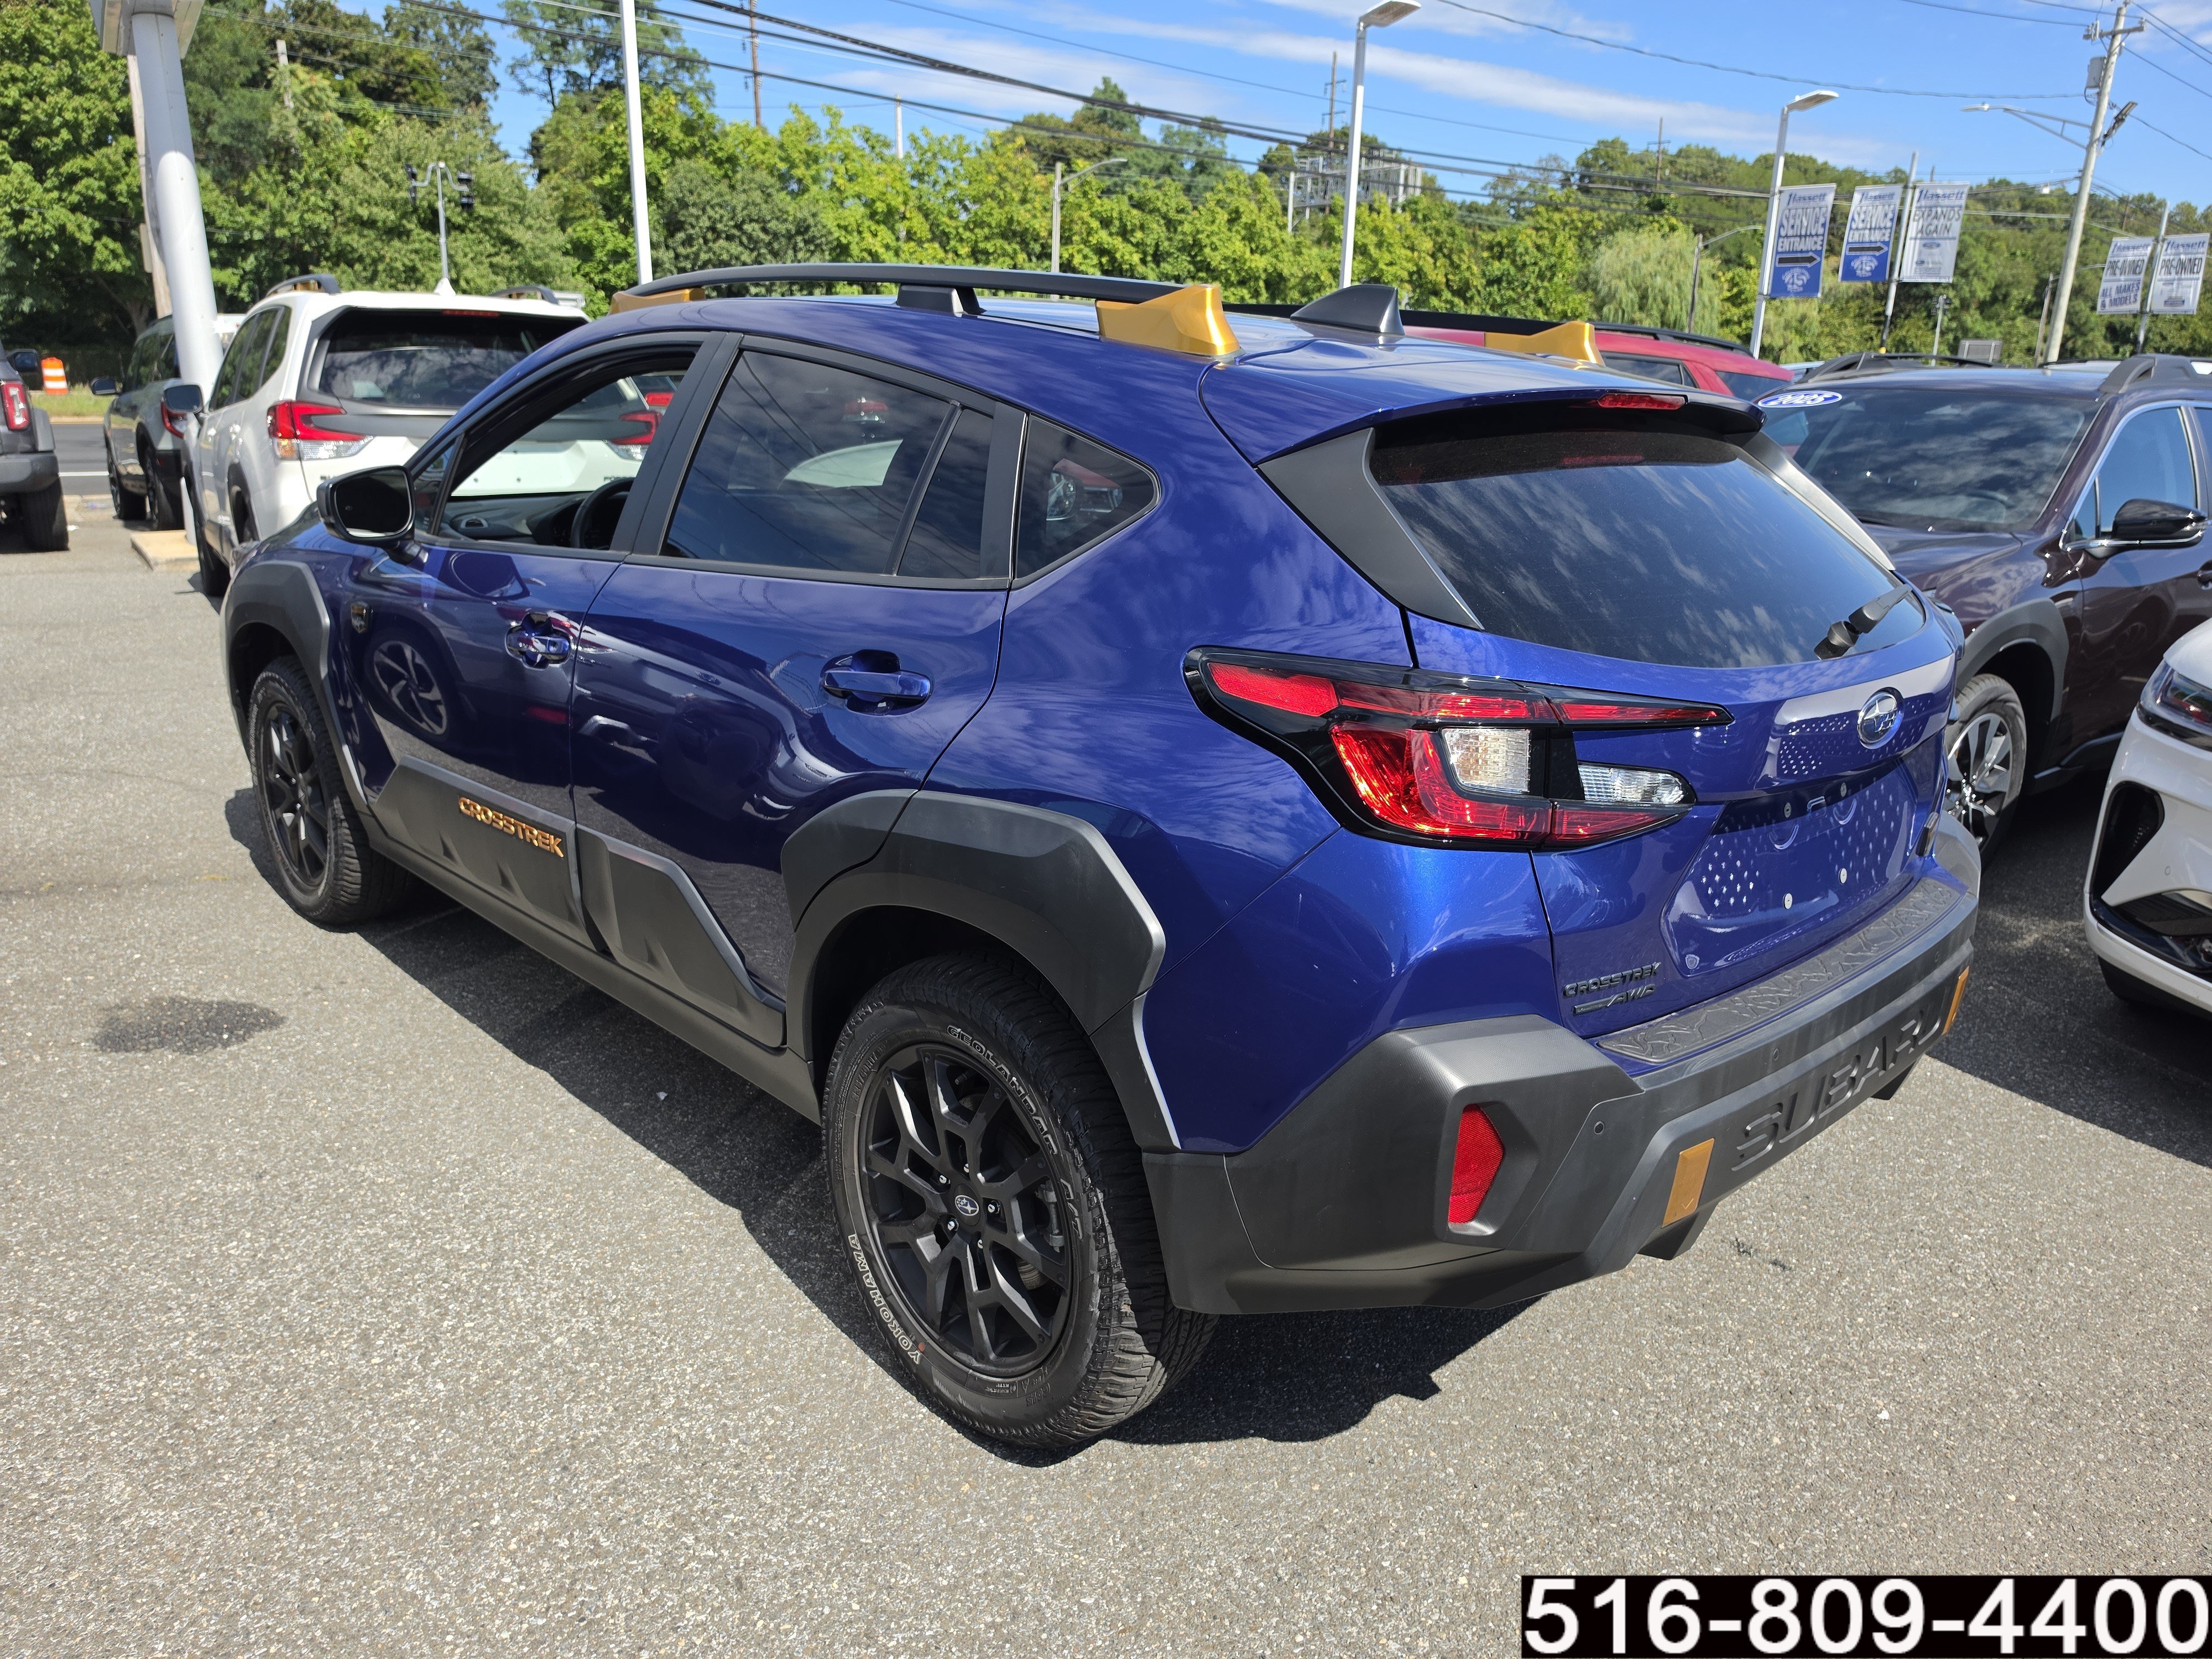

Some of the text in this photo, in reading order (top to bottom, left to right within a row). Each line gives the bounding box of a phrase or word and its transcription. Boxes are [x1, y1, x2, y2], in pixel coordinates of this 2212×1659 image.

[1780, 207, 1828, 237] SERVICE
[1852, 205, 1896, 229] SERVICE
[1913, 208, 1963, 222] EXPANDS
[1848, 228, 1891, 242] ENTRANCE
[1917, 222, 1953, 235] AGAIN
[1777, 236, 1824, 252] ENTRANCE
[2105, 258, 2145, 276] PRE-OWNED
[2159, 257, 2203, 275] PRE-OWNED
[2102, 281, 2141, 298] ALL MAKES
[2109, 294, 2138, 307] MODELS
[458, 797, 564, 858] CROSSTREK
[1563, 962, 1661, 997] CROSSTREK
[1606, 983, 1657, 1008] AWD
[947, 1024, 1058, 1155] GEOLANDAR
[1731, 1009, 1941, 1171] SUBARU
[1060, 1178, 1083, 1239] A/T
[848, 1234, 922, 1365] YOKOHAMA
